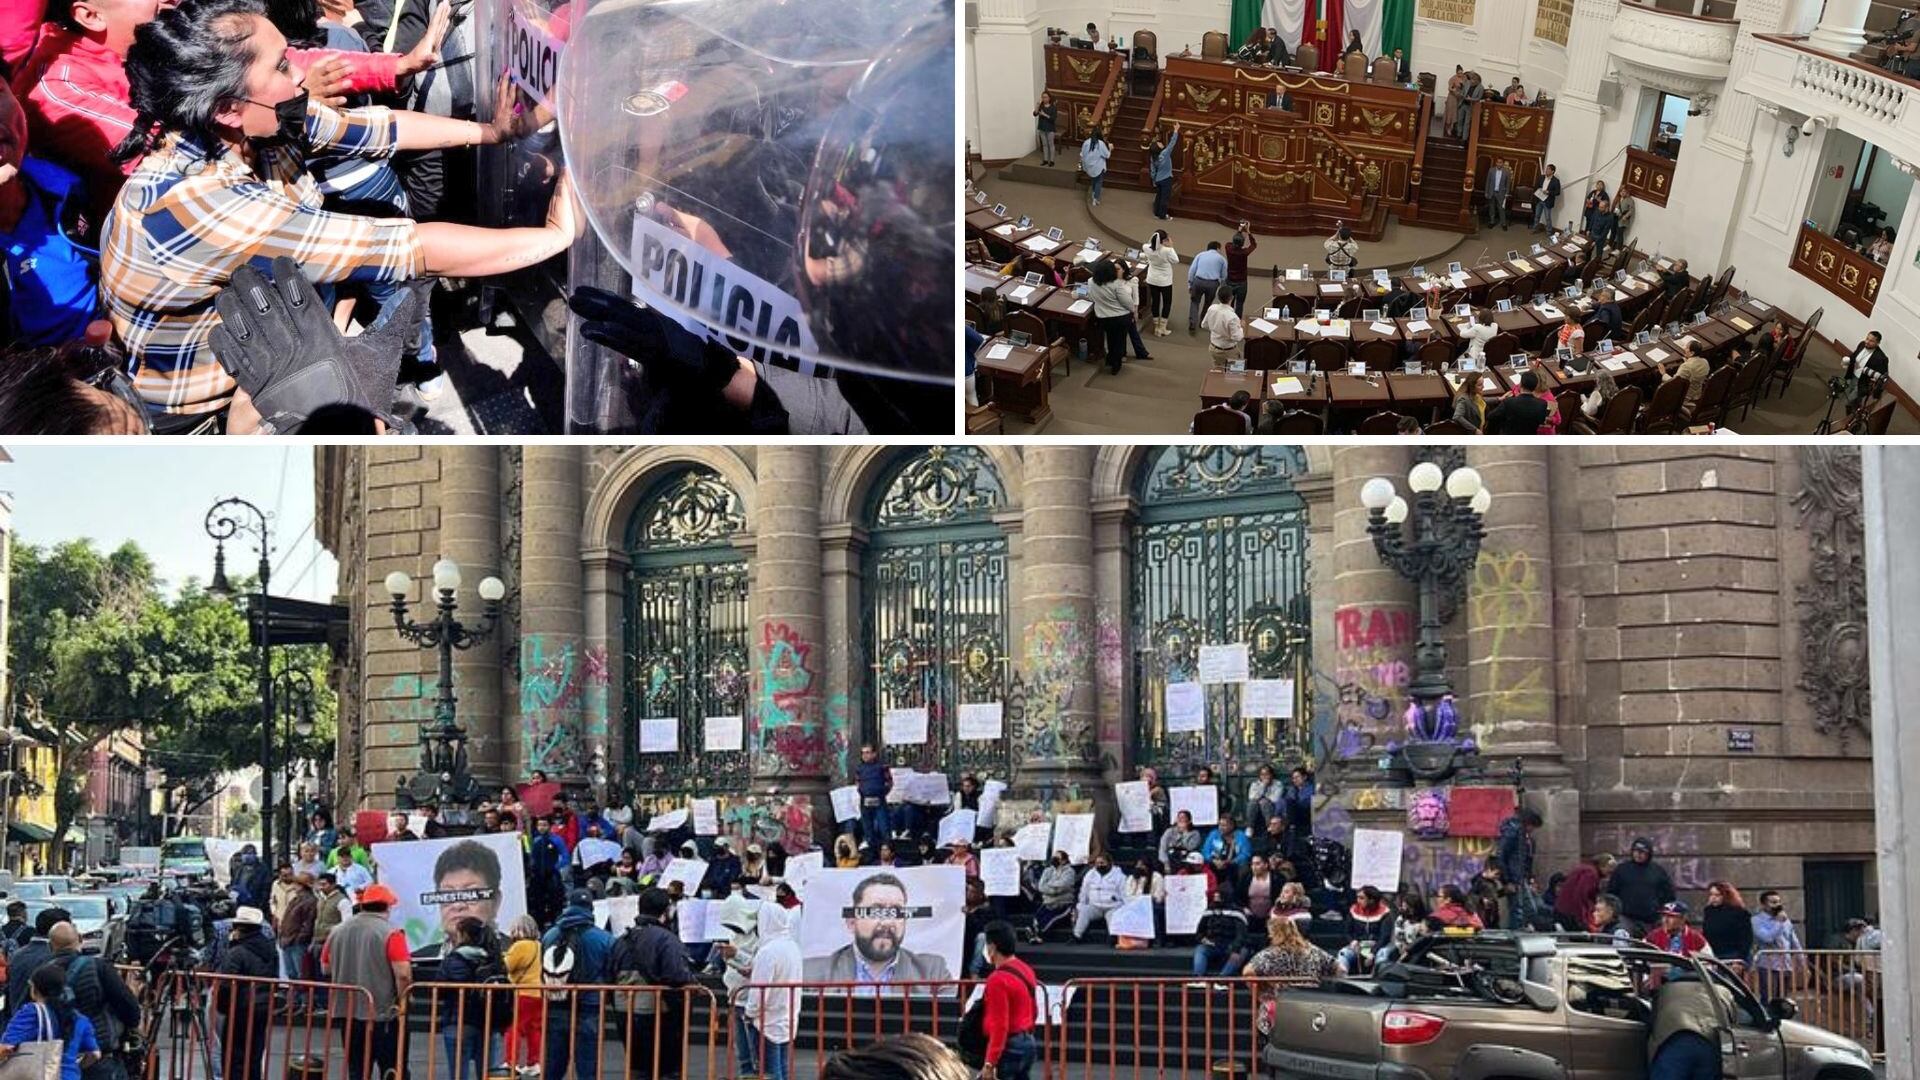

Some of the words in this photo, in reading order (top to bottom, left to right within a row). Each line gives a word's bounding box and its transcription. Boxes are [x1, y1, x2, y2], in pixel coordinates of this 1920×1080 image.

[640, 232, 806, 372] POLICIA
[423, 890, 479, 903] ERNESTINA
[854, 907, 897, 919] ULISES
